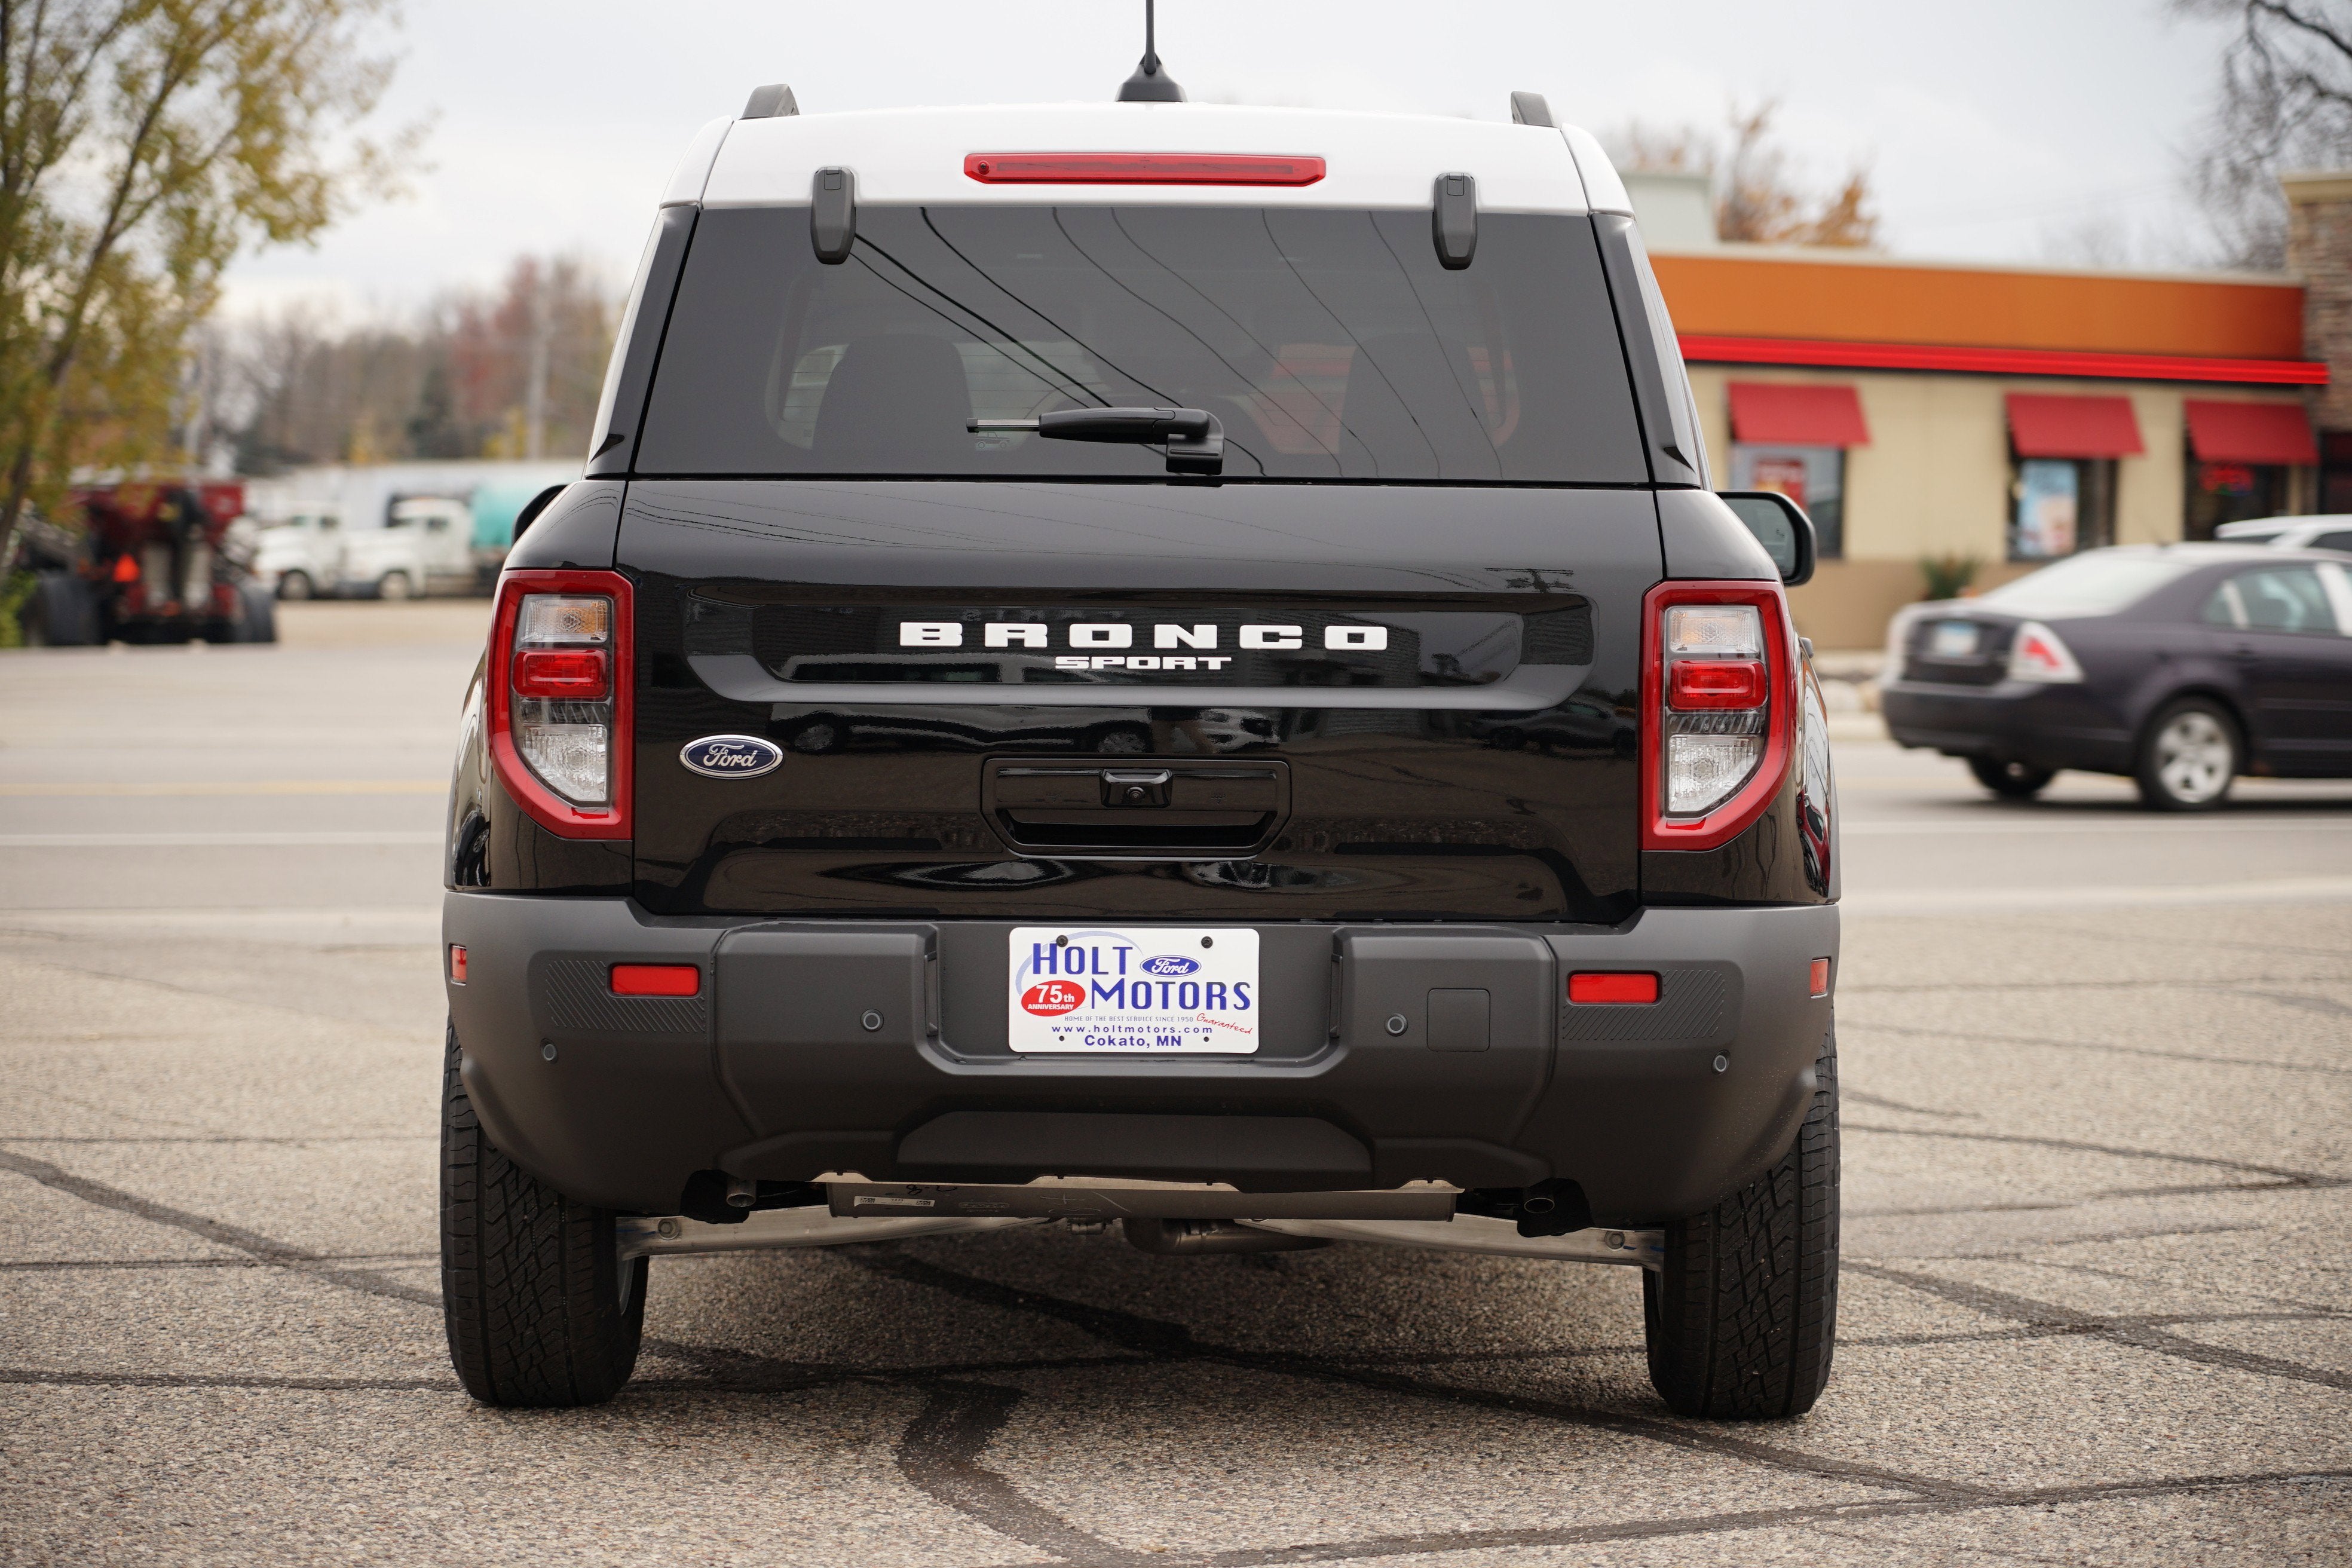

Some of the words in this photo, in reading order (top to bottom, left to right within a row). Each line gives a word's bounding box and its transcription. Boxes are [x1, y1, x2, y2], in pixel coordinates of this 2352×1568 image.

[899, 622, 1388, 650] BRONCO
[1055, 656, 1232, 670] SPORT
[703, 743, 757, 767] Ford
[1033, 943, 1133, 975] HOLT
[1151, 957, 1190, 975] Ford
[1036, 984, 1075, 1003] 75th
[1091, 978, 1251, 1010] MOTORS
[1052, 1024, 1213, 1034] www.holtmotors.com
[1196, 1013, 1253, 1034] Guaranteed
[1085, 1034, 1150, 1049] Cokato,
[1156, 1035, 1181, 1046] MN
